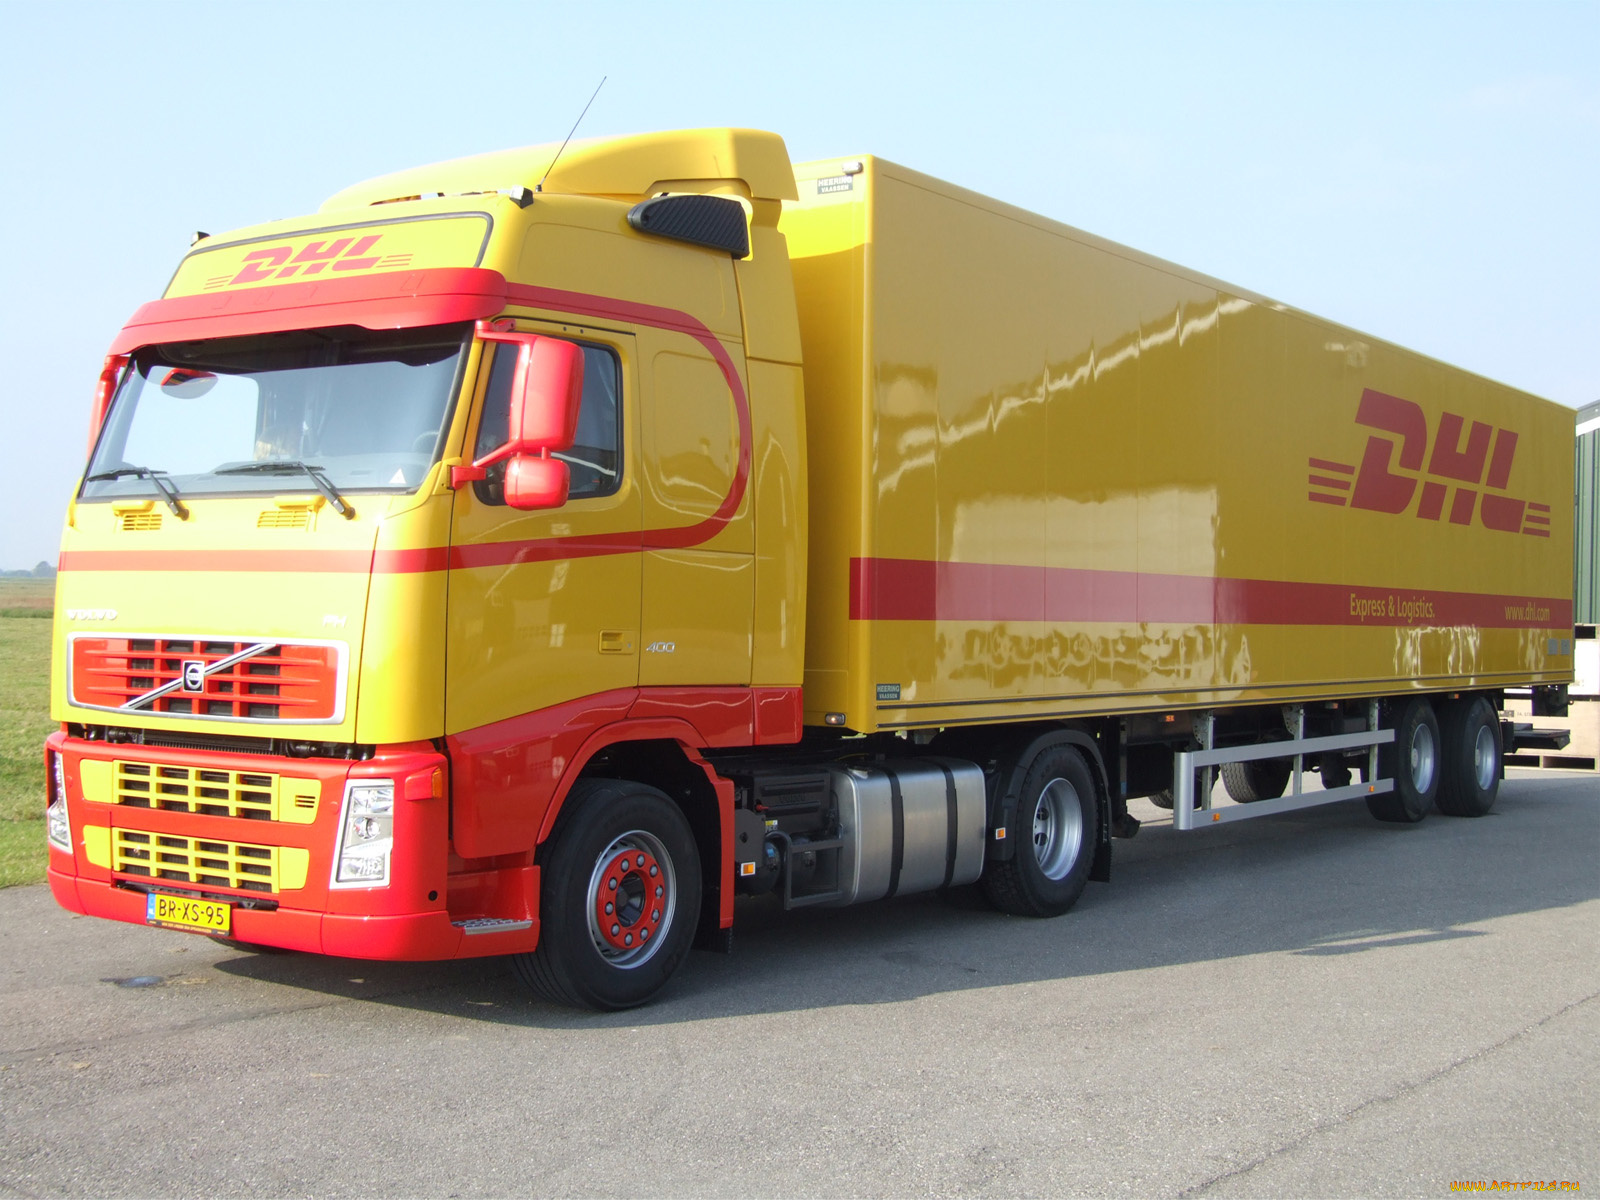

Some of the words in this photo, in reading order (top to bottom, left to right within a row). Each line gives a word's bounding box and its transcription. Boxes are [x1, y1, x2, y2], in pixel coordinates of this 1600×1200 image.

[228, 234, 383, 286] DHL
[1350, 387, 1526, 534] DHL
[66, 608, 118, 621] VOLVO
[1350, 593, 1386, 622] Express
[1388, 595, 1395, 617] &
[1505, 602, 1551, 622] www.dhl.com
[646, 641, 675, 653] 400
[159, 898, 224, 926] BR-XS-95
